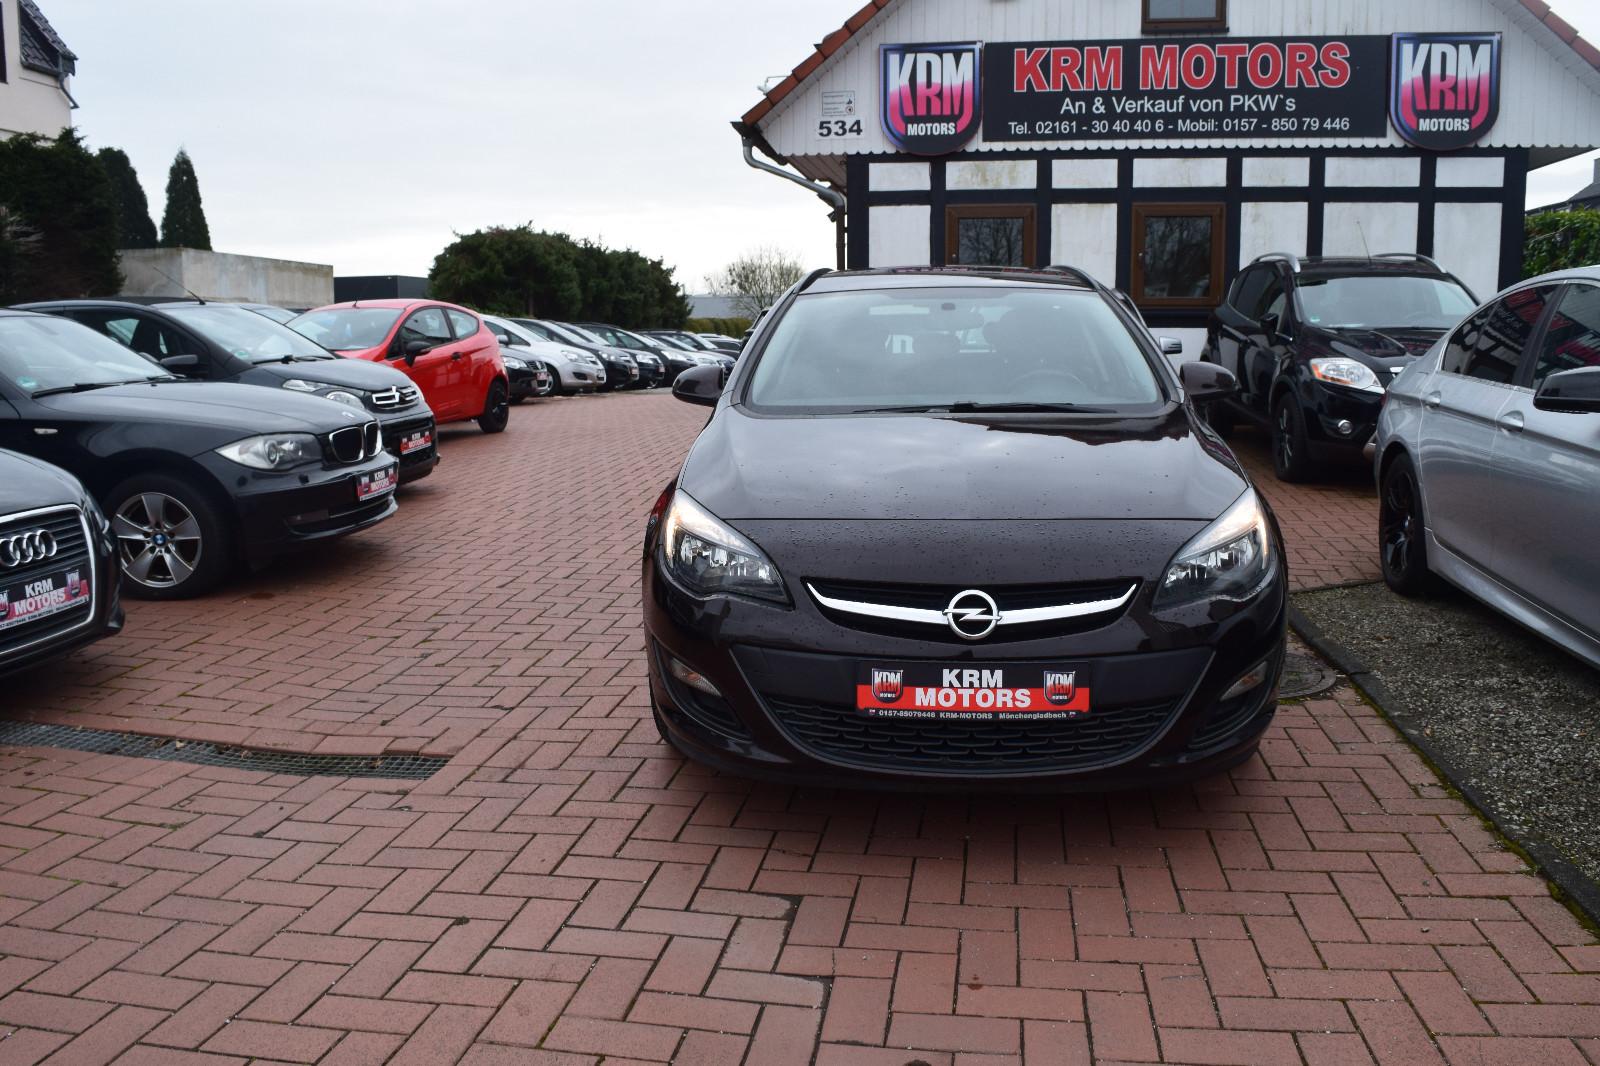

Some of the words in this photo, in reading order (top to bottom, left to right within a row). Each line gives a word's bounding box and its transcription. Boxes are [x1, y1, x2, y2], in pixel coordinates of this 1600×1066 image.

[1014, 46, 1123, 93] KRM
[1139, 41, 1351, 91] MOTORS
[1400, 42, 1492, 111] KRM
[888, 52, 974, 117] KRM
[1060, 97, 1086, 114] An
[1092, 96, 1106, 114] &
[1111, 95, 1185, 113] Verkauf
[1189, 99, 1223, 113] von
[818, 119, 863, 137] 534
[907, 122, 956, 136] MOTORS
[1008, 121, 1031, 135] Tel.
[1035, 121, 1077, 134] 02161
[1091, 120, 1109, 133] 30
[1112, 120, 1130, 133] 40
[1133, 119, 1151, 133] 40
[1177, 119, 1219, 132] Mobil:
[1223, 118, 1257, 132] 0157
[1271, 118, 1298, 131] 850
[1302, 118, 1319, 131] 79
[1323, 117, 1350, 131] 446
[1418, 118, 1470, 132] MOTORS
[25, 578, 54, 598] KRM
[14, 588, 66, 615] MOTORS
[942, 668, 1003, 689] KRM
[915, 687, 1032, 708] MOTORS
[939, 711, 993, 719] KRM-MOTORS
